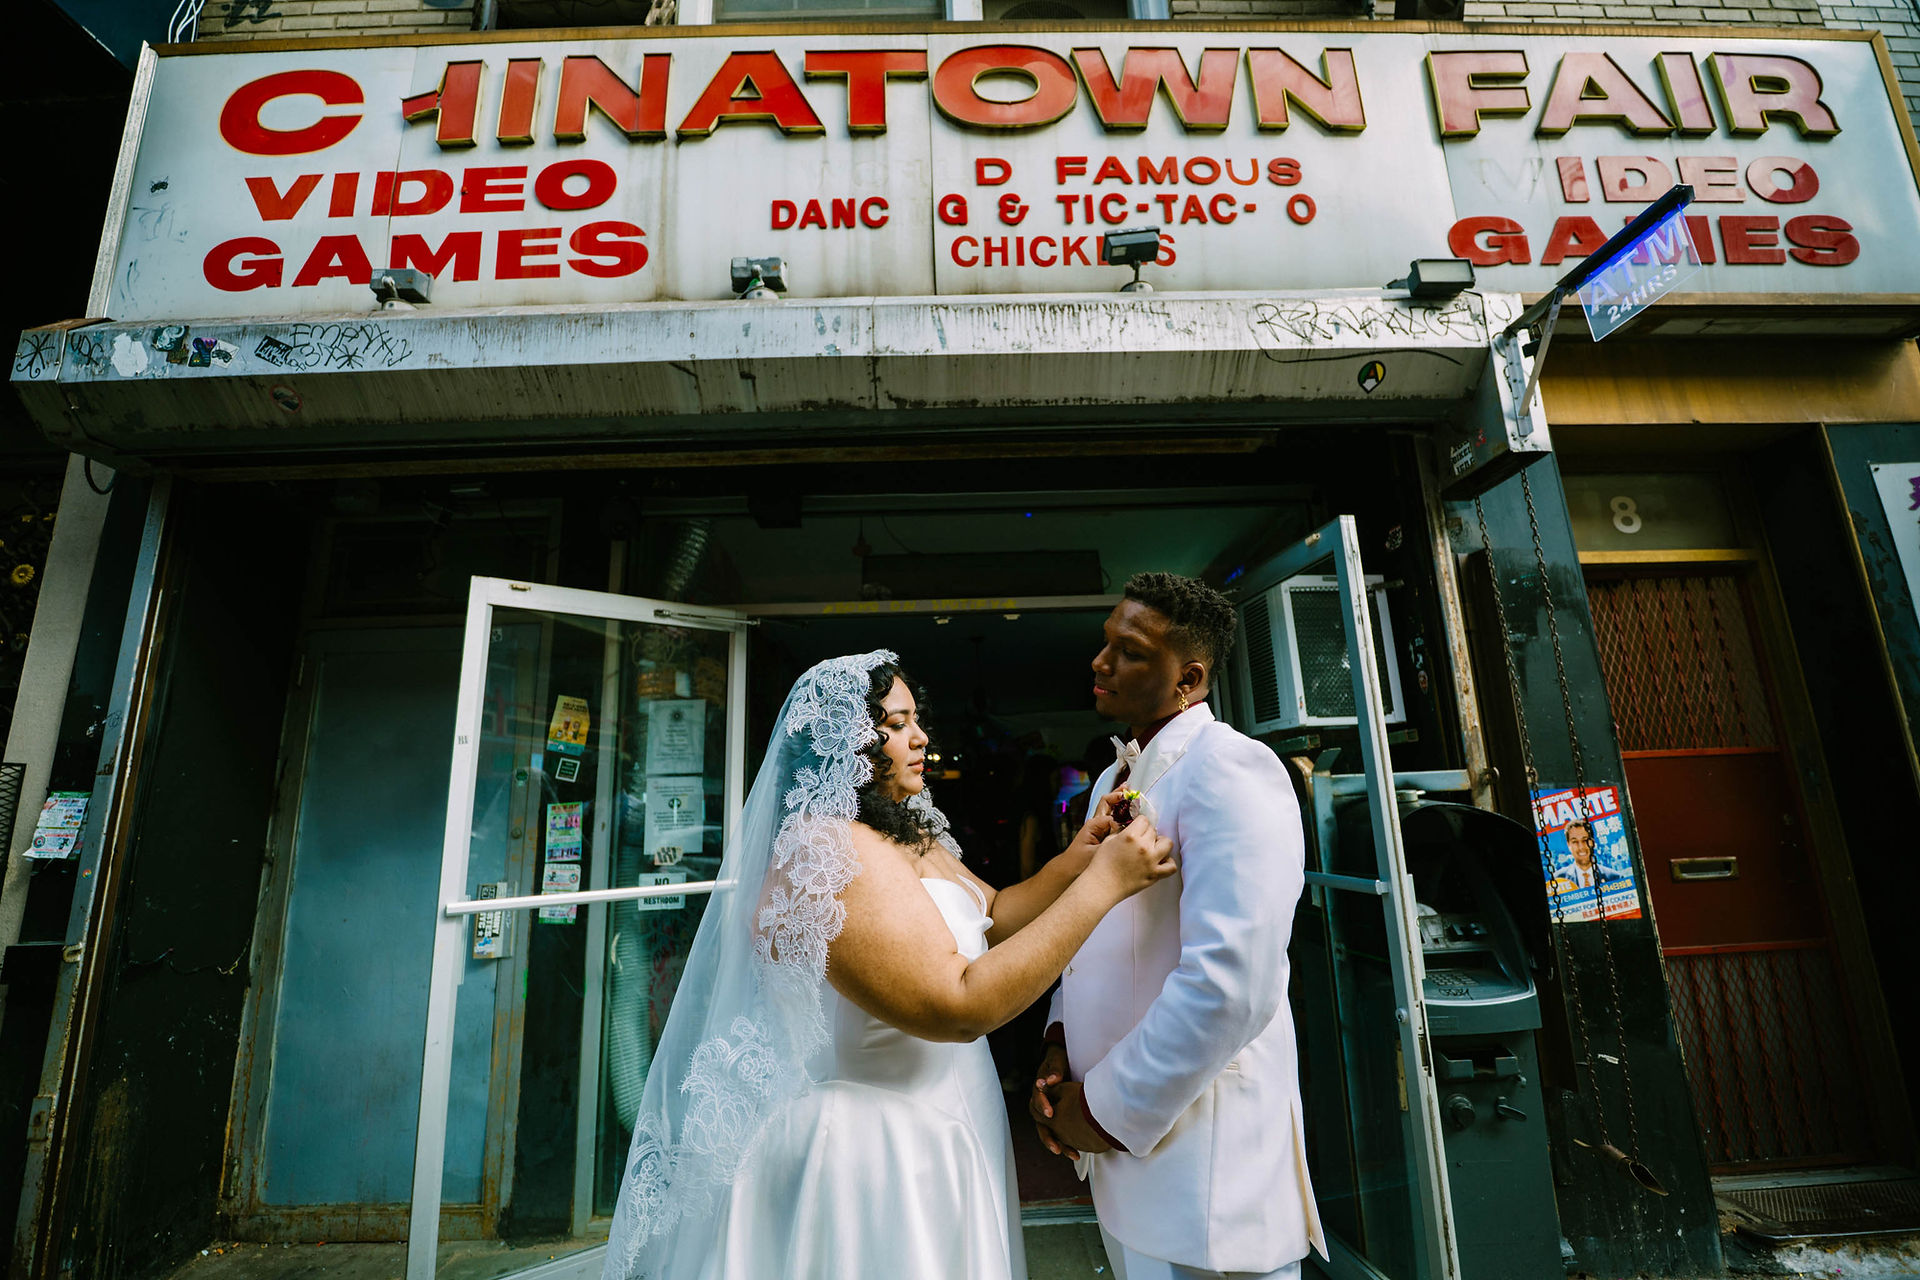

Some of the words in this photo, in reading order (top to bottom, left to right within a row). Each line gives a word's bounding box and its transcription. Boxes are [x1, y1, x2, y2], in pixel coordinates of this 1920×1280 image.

[1424, 50, 1842, 138] FAIR
[245, 160, 617, 221] VIDEO
[1055, 155, 1303, 187] FAMOUS
[998, 192, 1029, 226] &
[203, 221, 649, 292] GAMES
[950, 233, 1176, 267] CHICKS
[1448, 215, 1861, 267] GAMES
[1590, 213, 1689, 316] ATM
[1607, 264, 1677, 324] 24HRS
[1610, 495, 1642, 534] 8
[1532, 788, 1617, 831] MARTE
[643, 896, 680, 904] RESTROOM
[654, 877, 670, 886] NO
